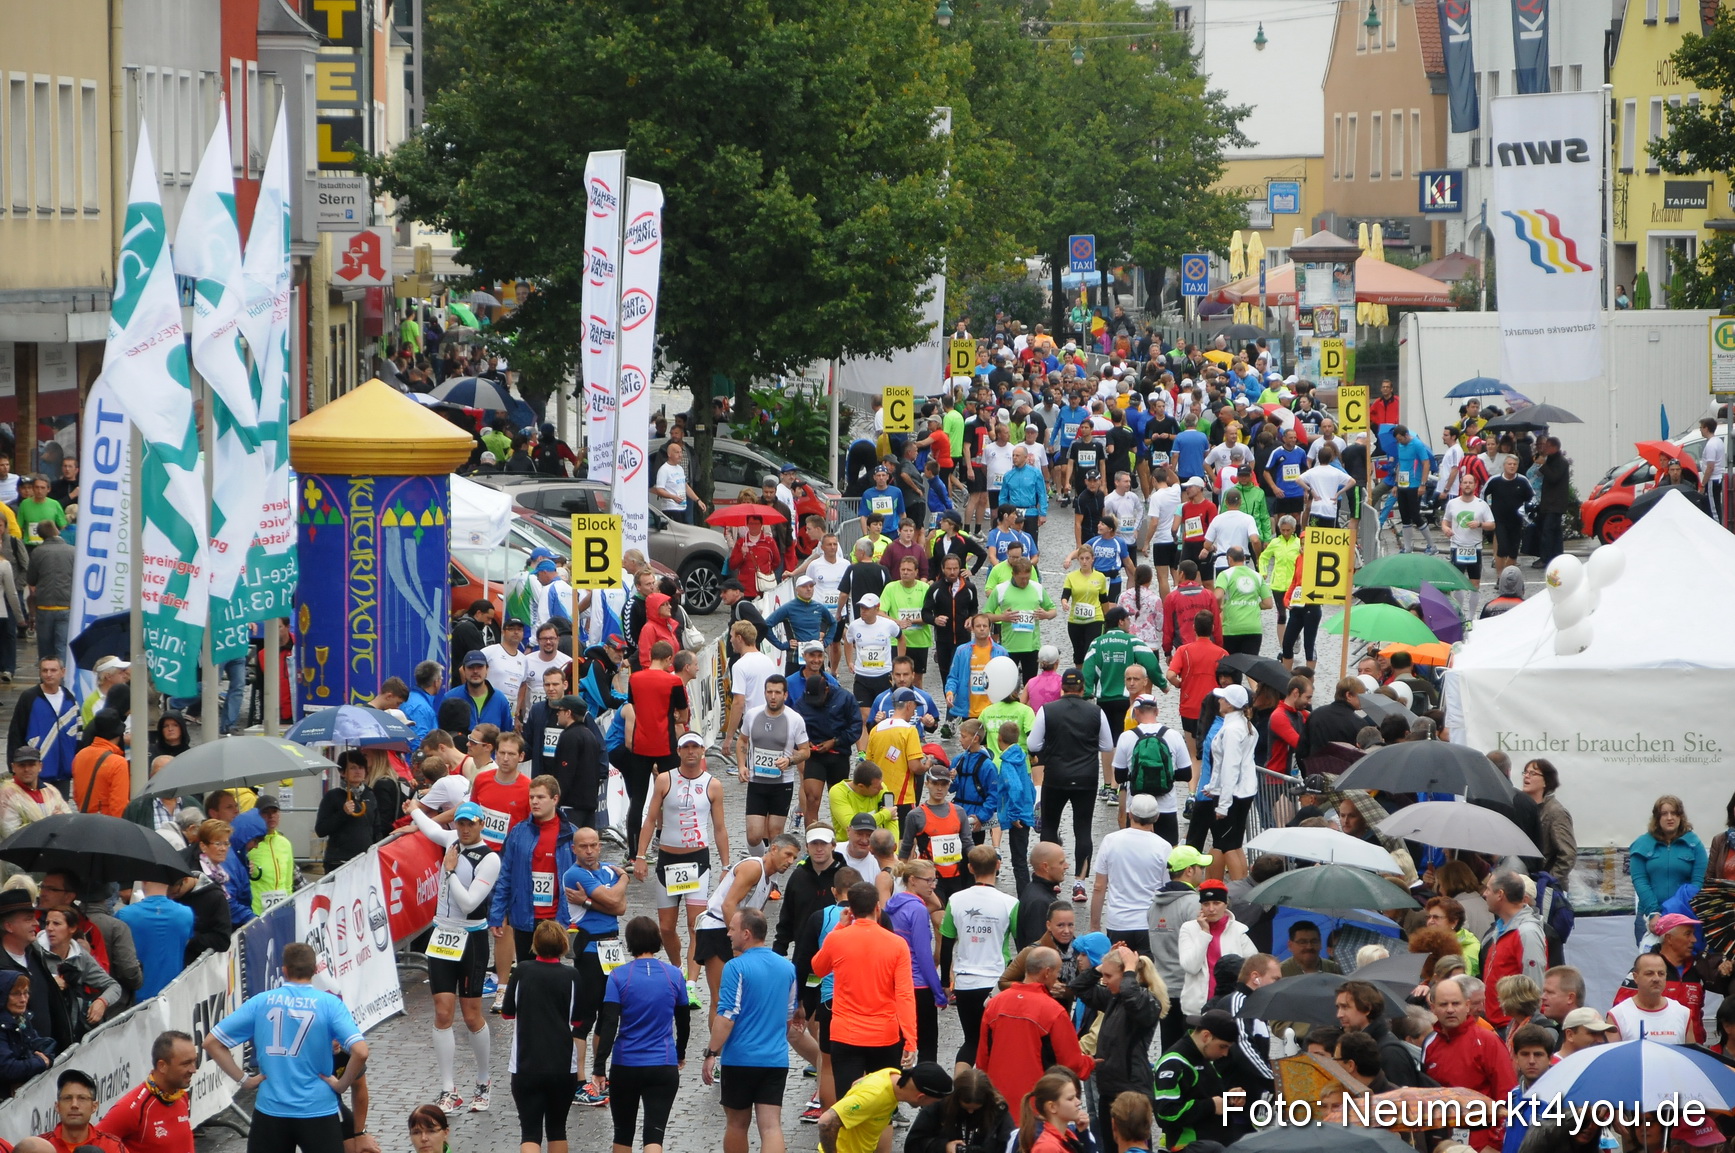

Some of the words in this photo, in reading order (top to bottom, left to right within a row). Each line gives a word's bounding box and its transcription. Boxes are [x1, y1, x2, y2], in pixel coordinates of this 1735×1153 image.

[318, 194, 355, 205] Stern
[1666, 198, 1705, 206] TAIFUN
[1072, 261, 1094, 270] TAXI
[1184, 282, 1207, 293] TAXI
[953, 339, 973, 348] Block
[1323, 340, 1344, 348] Block
[956, 351, 969, 369] D
[1327, 350, 1340, 369] D
[886, 386, 910, 397] Block
[1341, 387, 1366, 397] Block
[889, 400, 906, 422] C
[1345, 400, 1362, 422] C
[1079, 454, 1096, 462] 3141
[875, 501, 889, 509] 581
[116, 490, 131, 555] power
[577, 517, 616, 531] Block
[1310, 530, 1350, 546] Block
[585, 537, 609, 573] B
[1314, 550, 1341, 587] B
[1075, 606, 1093, 617] 5130
[868, 651, 879, 660] 82
[1496, 731, 1571, 752] Kinder
[1576, 731, 1675, 753] brauchen
[1684, 731, 1722, 753] Sie.
[1603, 754, 1722, 766] www.phytokids-stiftung.de
[942, 842, 955, 854] 98
[675, 870, 689, 883] 23
[966, 925, 993, 934] 21,098
[437, 933, 460, 948] 502
[267, 994, 318, 1009] HAMSIK
[265, 1007, 316, 1058] 17
